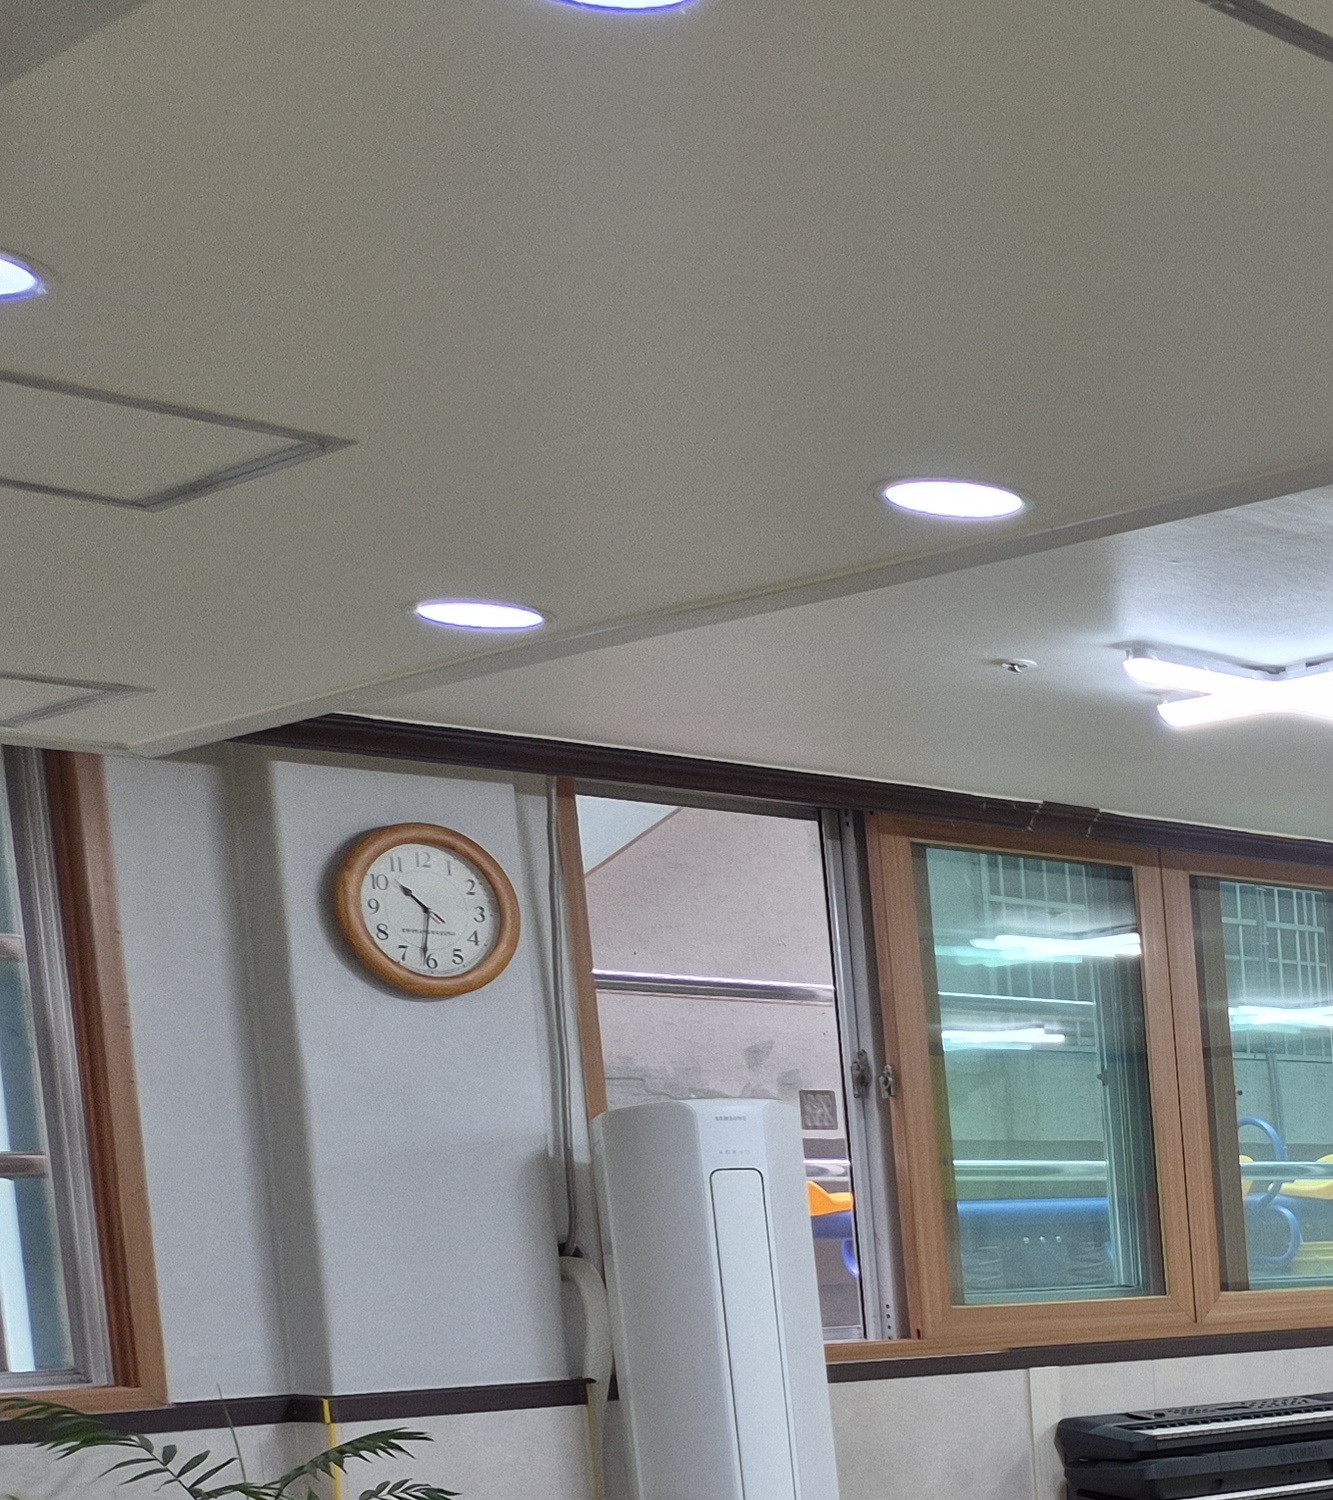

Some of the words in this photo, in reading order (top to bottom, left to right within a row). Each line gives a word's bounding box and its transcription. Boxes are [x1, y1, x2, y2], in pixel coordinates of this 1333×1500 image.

[390, 856, 403, 872] 11
[415, 852, 431, 868] 12
[446, 860, 453, 876] 1
[370, 873, 389, 890] 10
[466, 879, 476, 895] 2
[367, 898, 380, 914] 9
[474, 906, 486, 923] 3
[376, 923, 389, 940] 8
[467, 930, 480, 946] 4
[398, 945, 409, 962] 7
[426, 953, 438, 969] 6
[451, 949, 464, 965] 5
